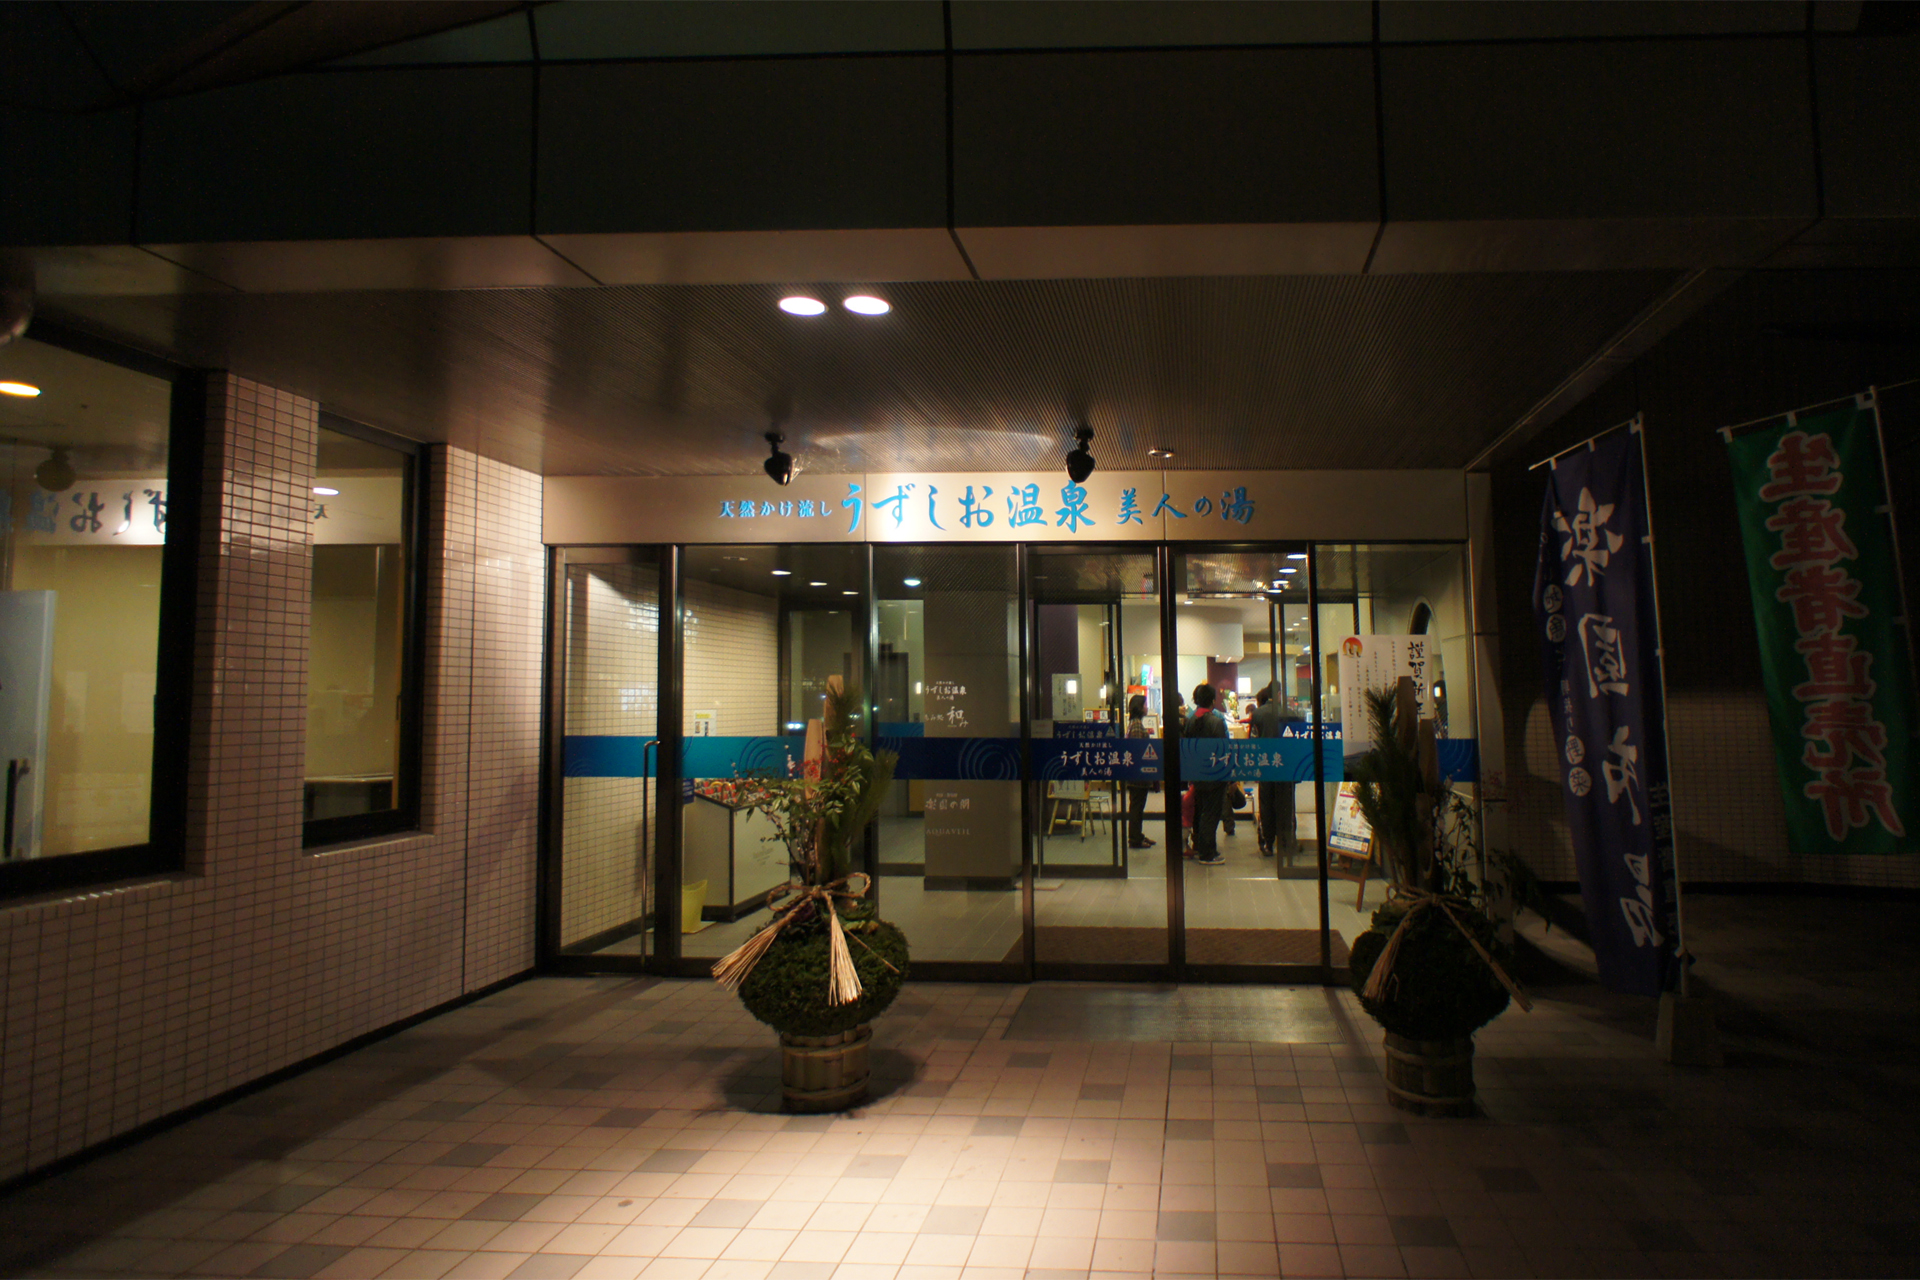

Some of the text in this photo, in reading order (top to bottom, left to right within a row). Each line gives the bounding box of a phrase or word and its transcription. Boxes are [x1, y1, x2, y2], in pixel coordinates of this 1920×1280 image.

[718, 481, 1256, 534] 天然かけ流し うずしお温泉 美人の湯
[1061, 750, 1135, 767] うずしお温泉
[1209, 751, 1284, 768] うずしお温泉
[1081, 767, 1112, 777] 美人の湯
